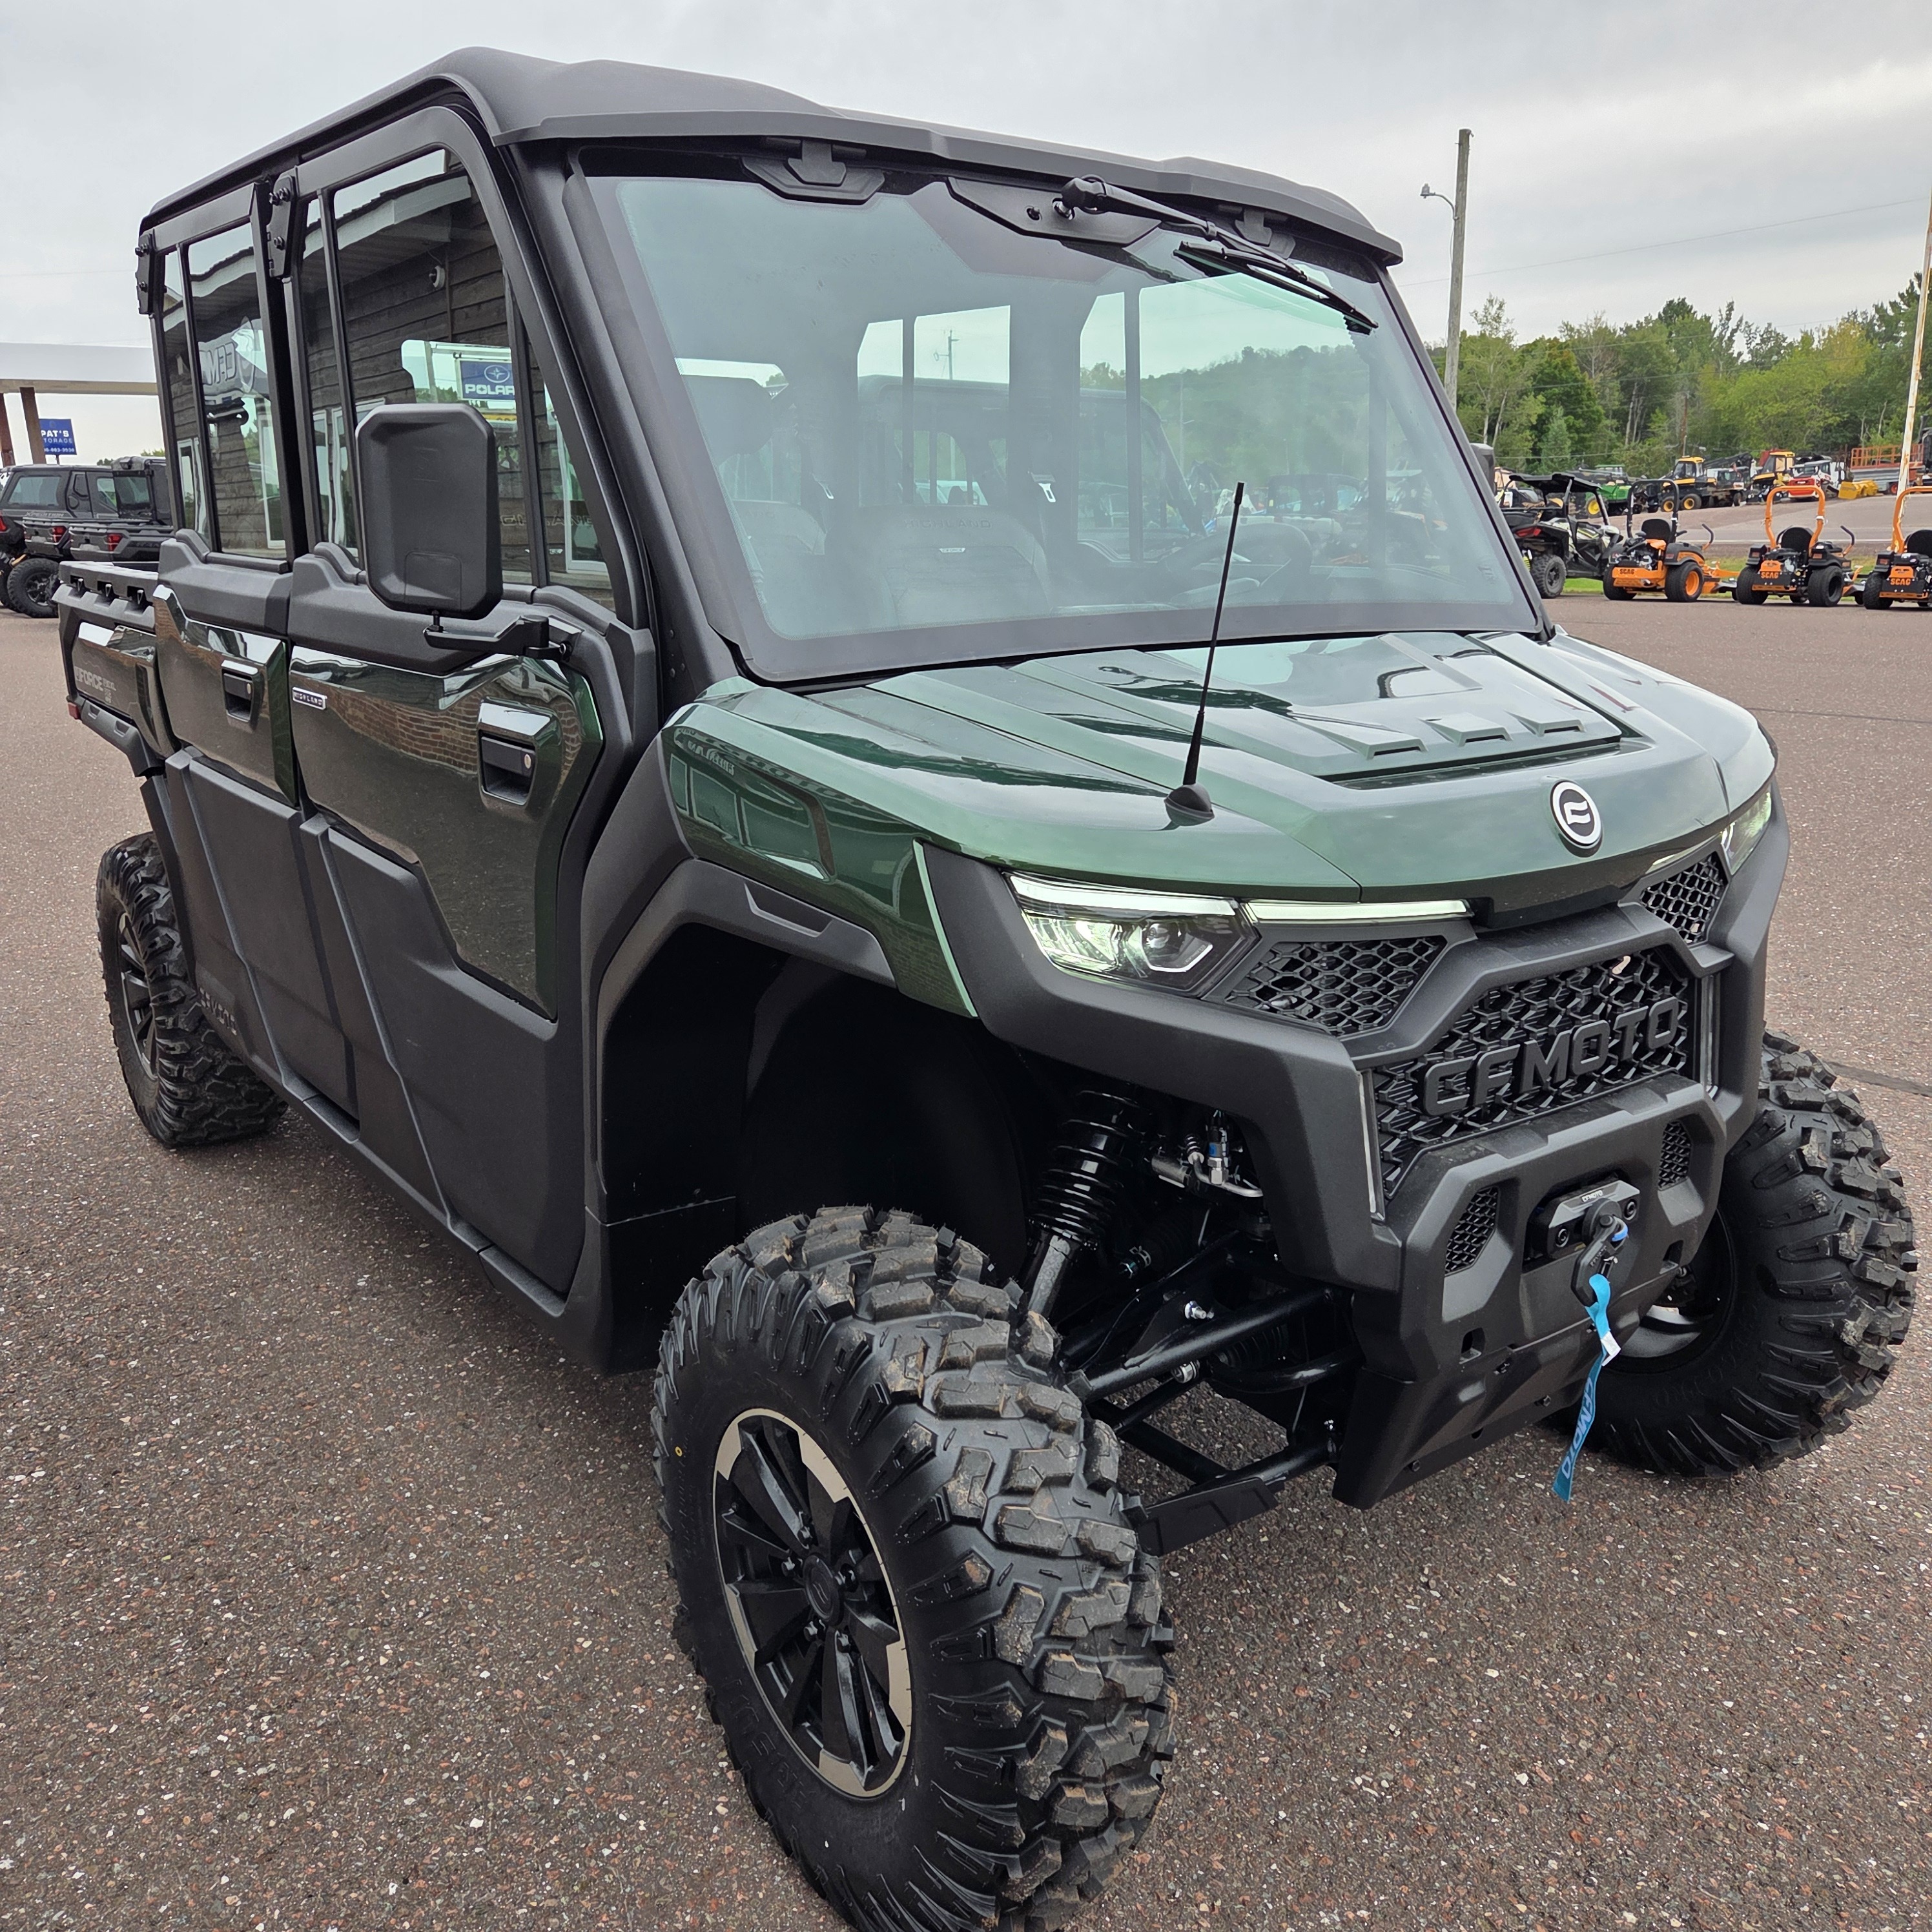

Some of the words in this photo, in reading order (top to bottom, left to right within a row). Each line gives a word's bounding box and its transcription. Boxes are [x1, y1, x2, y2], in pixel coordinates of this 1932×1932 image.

[465, 384, 515, 395] POLAR
[1424, 996, 1679, 1116] CFMOTO
[1581, 1189, 1604, 1202] CFMOTO
